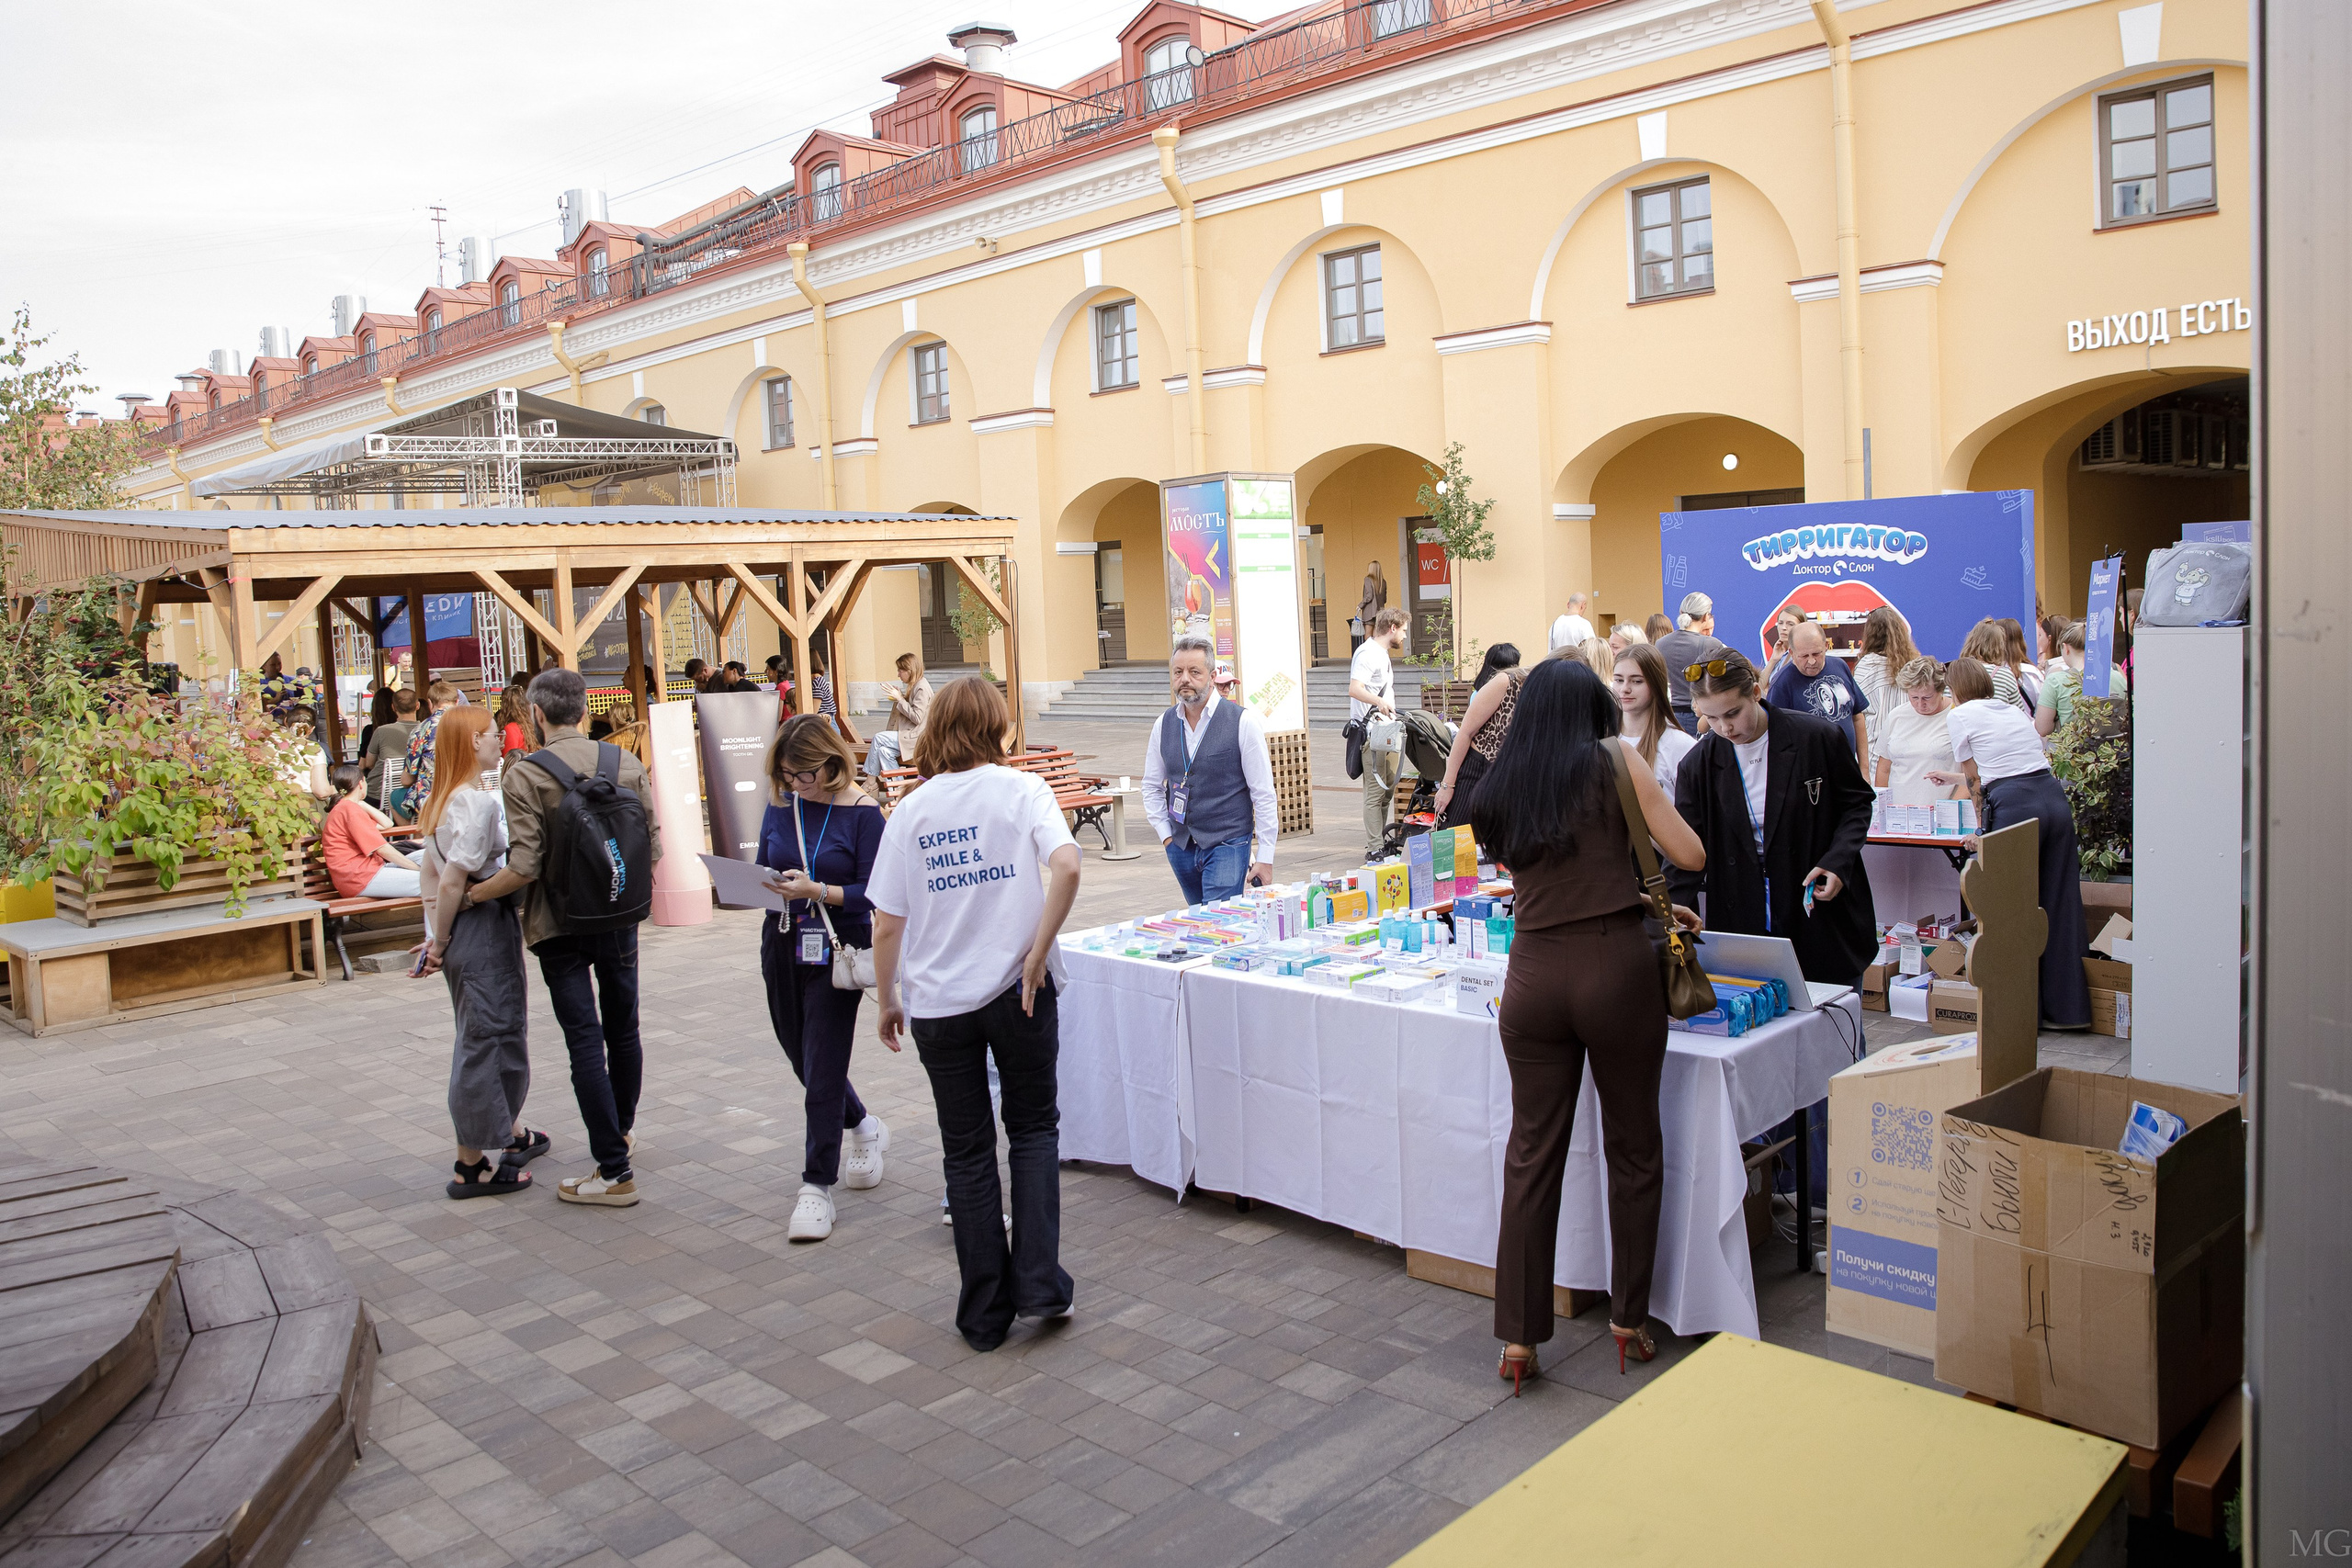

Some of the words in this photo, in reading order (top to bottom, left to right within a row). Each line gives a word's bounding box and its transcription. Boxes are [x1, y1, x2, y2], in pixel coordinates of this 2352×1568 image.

[2067, 308, 2171, 353] ВЫХОД
[2180, 297, 2252, 337] ЕСТЬ
[1170, 512, 1225, 532] МОСТЪ
[1743, 526, 1928, 564] ТИРРИГАТОР
[1420, 558, 1440, 571] WC
[1792, 564, 1832, 576] Доктор
[1849, 562, 1874, 573] Слон
[719, 742, 764, 751] BRIGHTENING
[722, 736, 762, 744] MOONLIGHT
[919, 825, 978, 850] EXPERT
[608, 837, 626, 895] TUMLARE
[925, 850, 969, 871] SMILE
[972, 848, 984, 863] &
[609, 865, 620, 902] KUONI
[927, 863, 1016, 893] ROCKNROLL
[1460, 984, 1478, 993] BASIC
[1461, 976, 1483, 986] DENTAL
[1483, 979, 1494, 987] SET
[1936, 1009, 1977, 1021] CURAPROX
[1854, 1171, 1861, 1184] 1
[1893, 1182, 1923, 1194] старую
[1851, 1197, 1862, 1211] 2
[1871, 1198, 1914, 1214] Используй
[1882, 1212, 1916, 1227] покупку
[1837, 1249, 1884, 1271] Получи
[1886, 1264, 1936, 1287] скидку
[1836, 1267, 1849, 1277] на
[1850, 1270, 1894, 1291] покупку
[1895, 1281, 1928, 1296] новой
